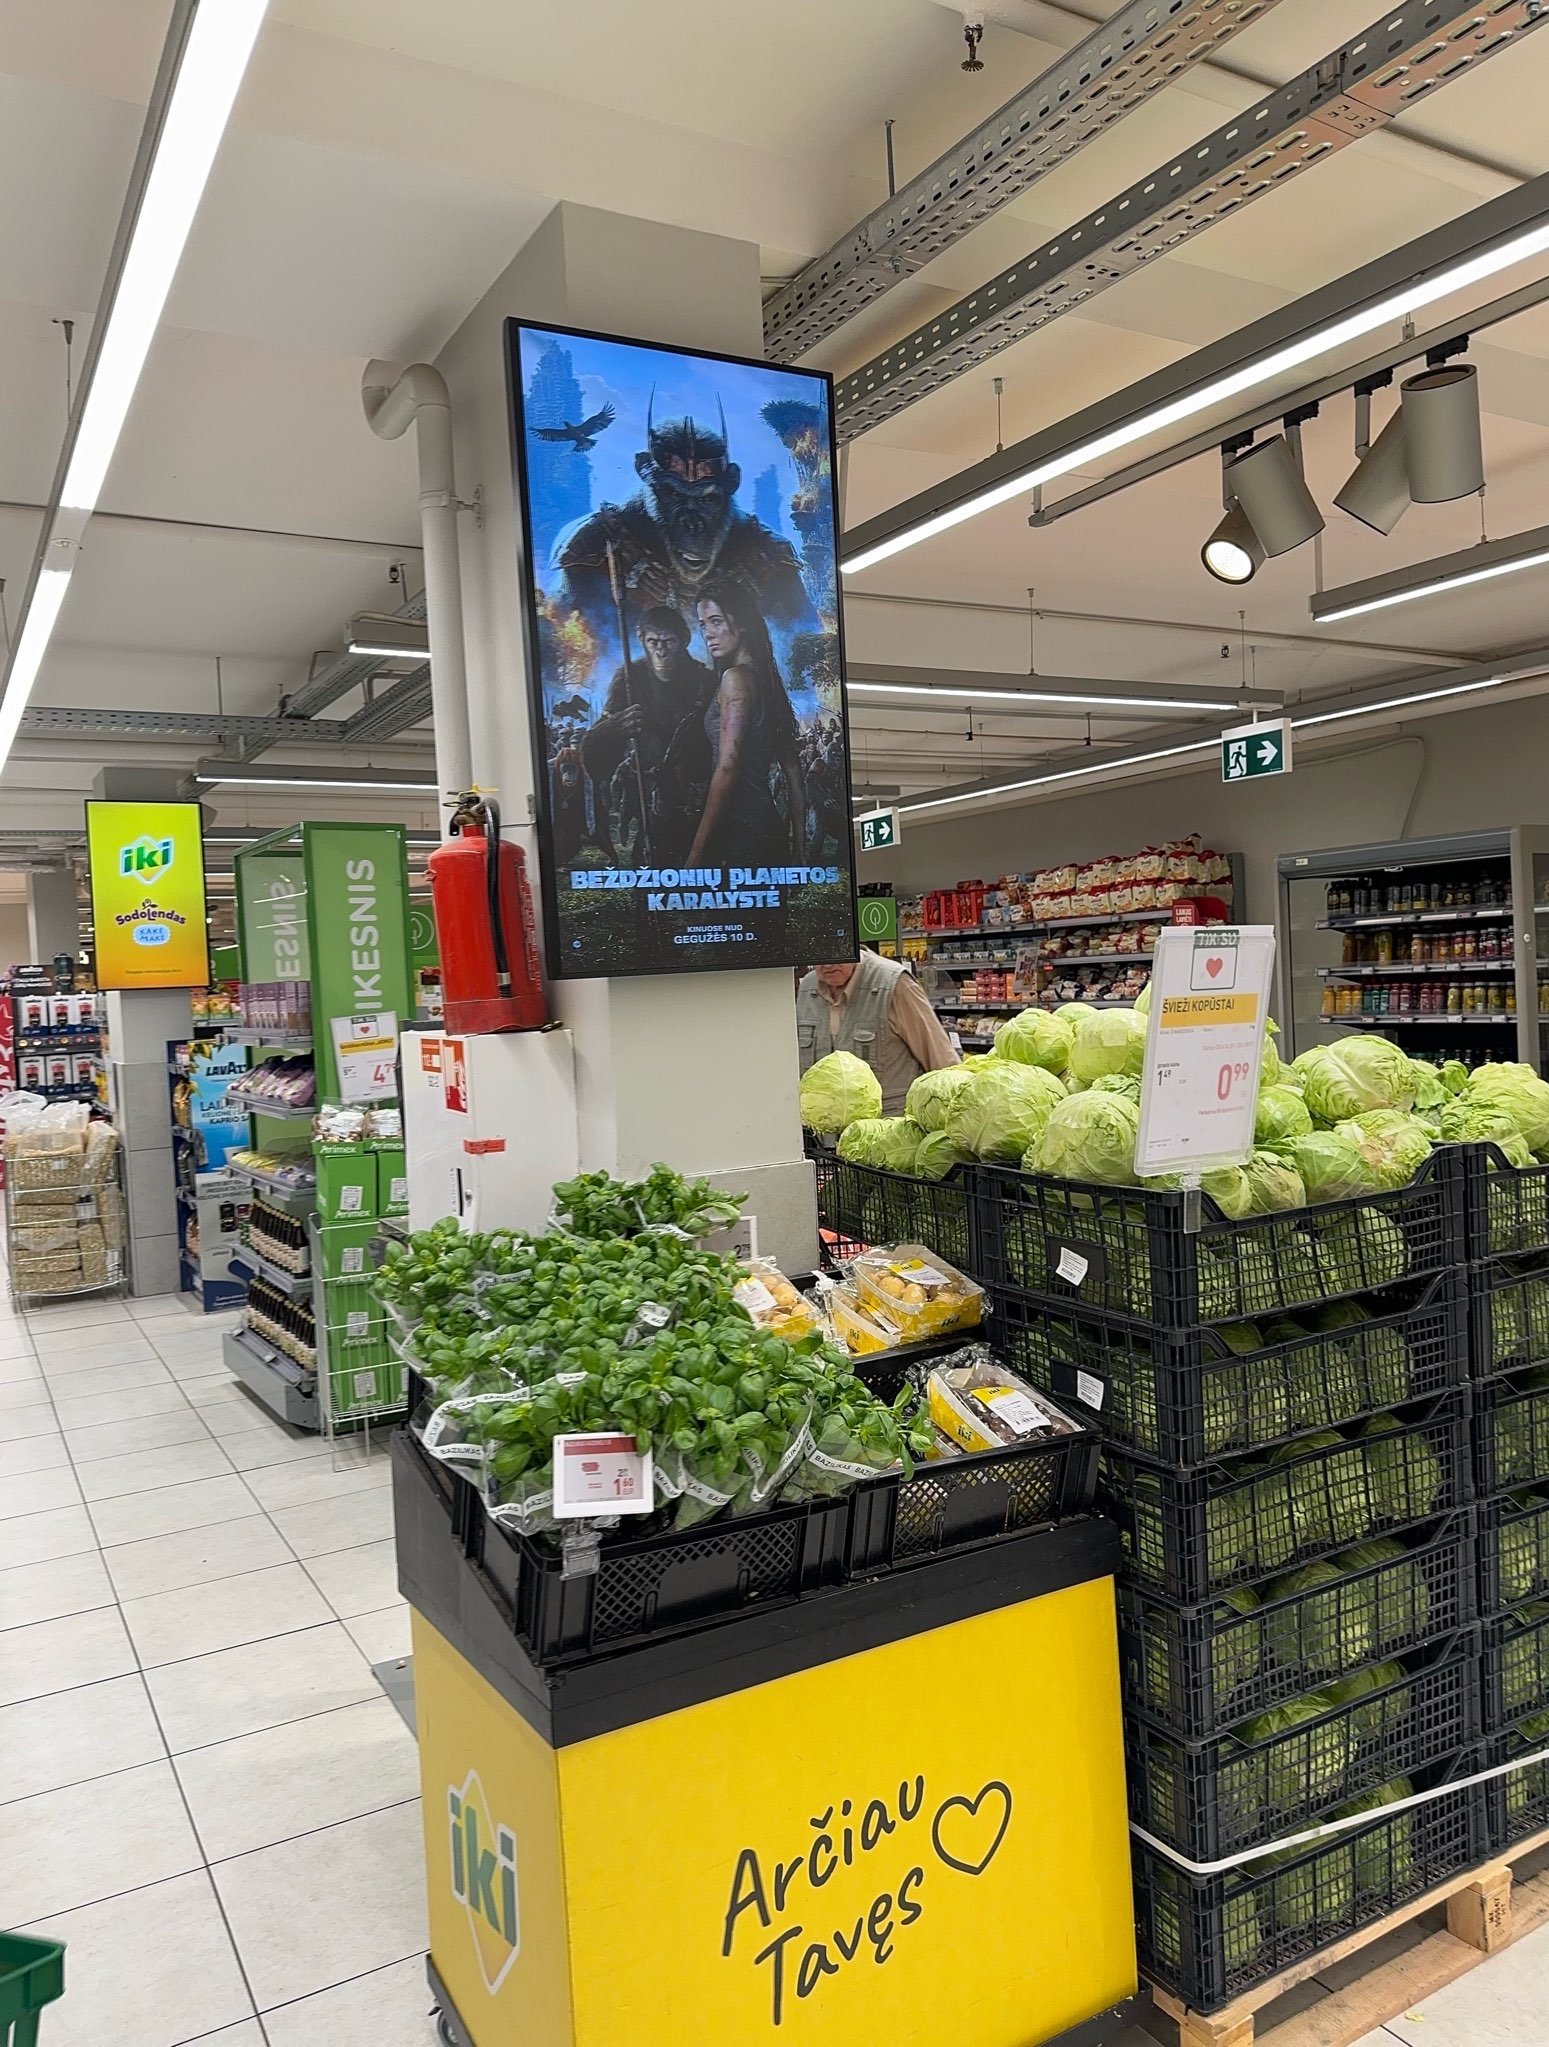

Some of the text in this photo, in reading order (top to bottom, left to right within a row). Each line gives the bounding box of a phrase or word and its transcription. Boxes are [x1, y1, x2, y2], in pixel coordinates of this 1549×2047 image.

[124, 841, 171, 873] iki
[570, 866, 839, 891] BEŽDŽIONIŲ PLANETOS
[648, 885, 780, 911] KARALYSTĖ
[673, 932, 758, 944] GEGUŽĖS 10 D.
[687, 924, 743, 933] KINUOSE NUO
[1162, 997, 1235, 1013] ŠVIEŽI KOPŪSTAI
[850, 1328, 860, 1340] iki
[957, 1425, 972, 1441] iki
[815, 1455, 852, 1470] BAZILIKAS
[449, 1792, 517, 1947] iki
[721, 1775, 924, 1957] Arčiau
[754, 1866, 924, 2026] Tavęs
